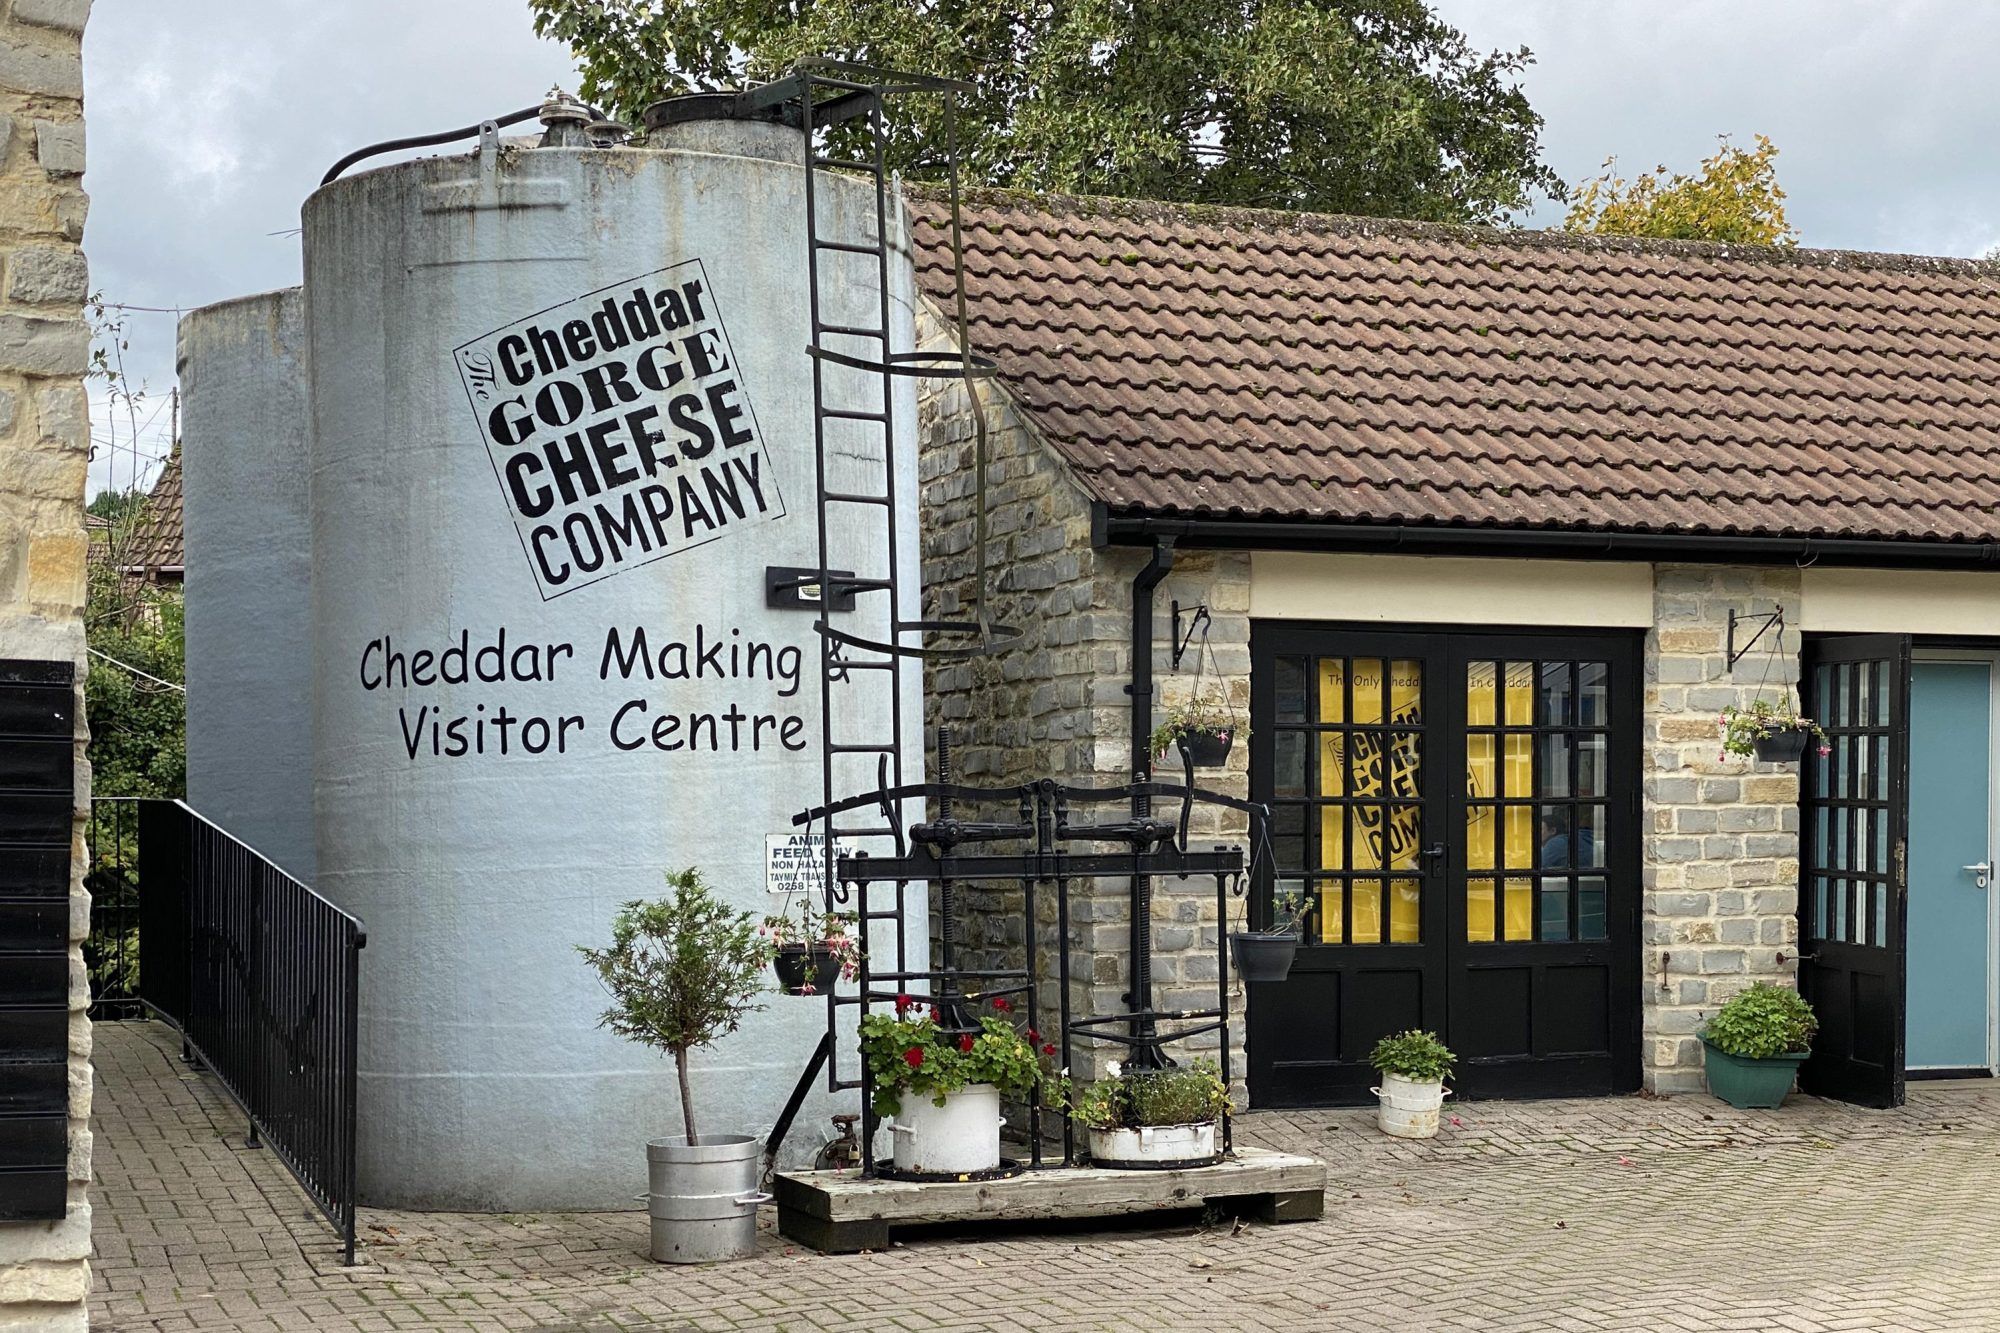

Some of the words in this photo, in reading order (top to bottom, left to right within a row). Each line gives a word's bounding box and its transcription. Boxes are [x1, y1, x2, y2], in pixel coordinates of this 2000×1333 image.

[497, 279, 706, 386] Cheddar
[462, 347, 500, 403] The
[488, 328, 731, 447] GORGE
[505, 379, 754, 519] CHEESE
[530, 452, 768, 586] COMPANY
[360, 627, 574, 690] Cheddar
[600, 624, 802, 697] Making
[1328, 674, 1343, 686] Th
[1353, 675, 1381, 689] Only
[399, 703, 585, 760] Visitor
[610, 699, 808, 752] Centre
[772, 861, 794, 870] NON
[773, 847, 813, 859] FEED
[788, 835, 842, 846] ANIML
[777, 882, 804, 891] 0258
